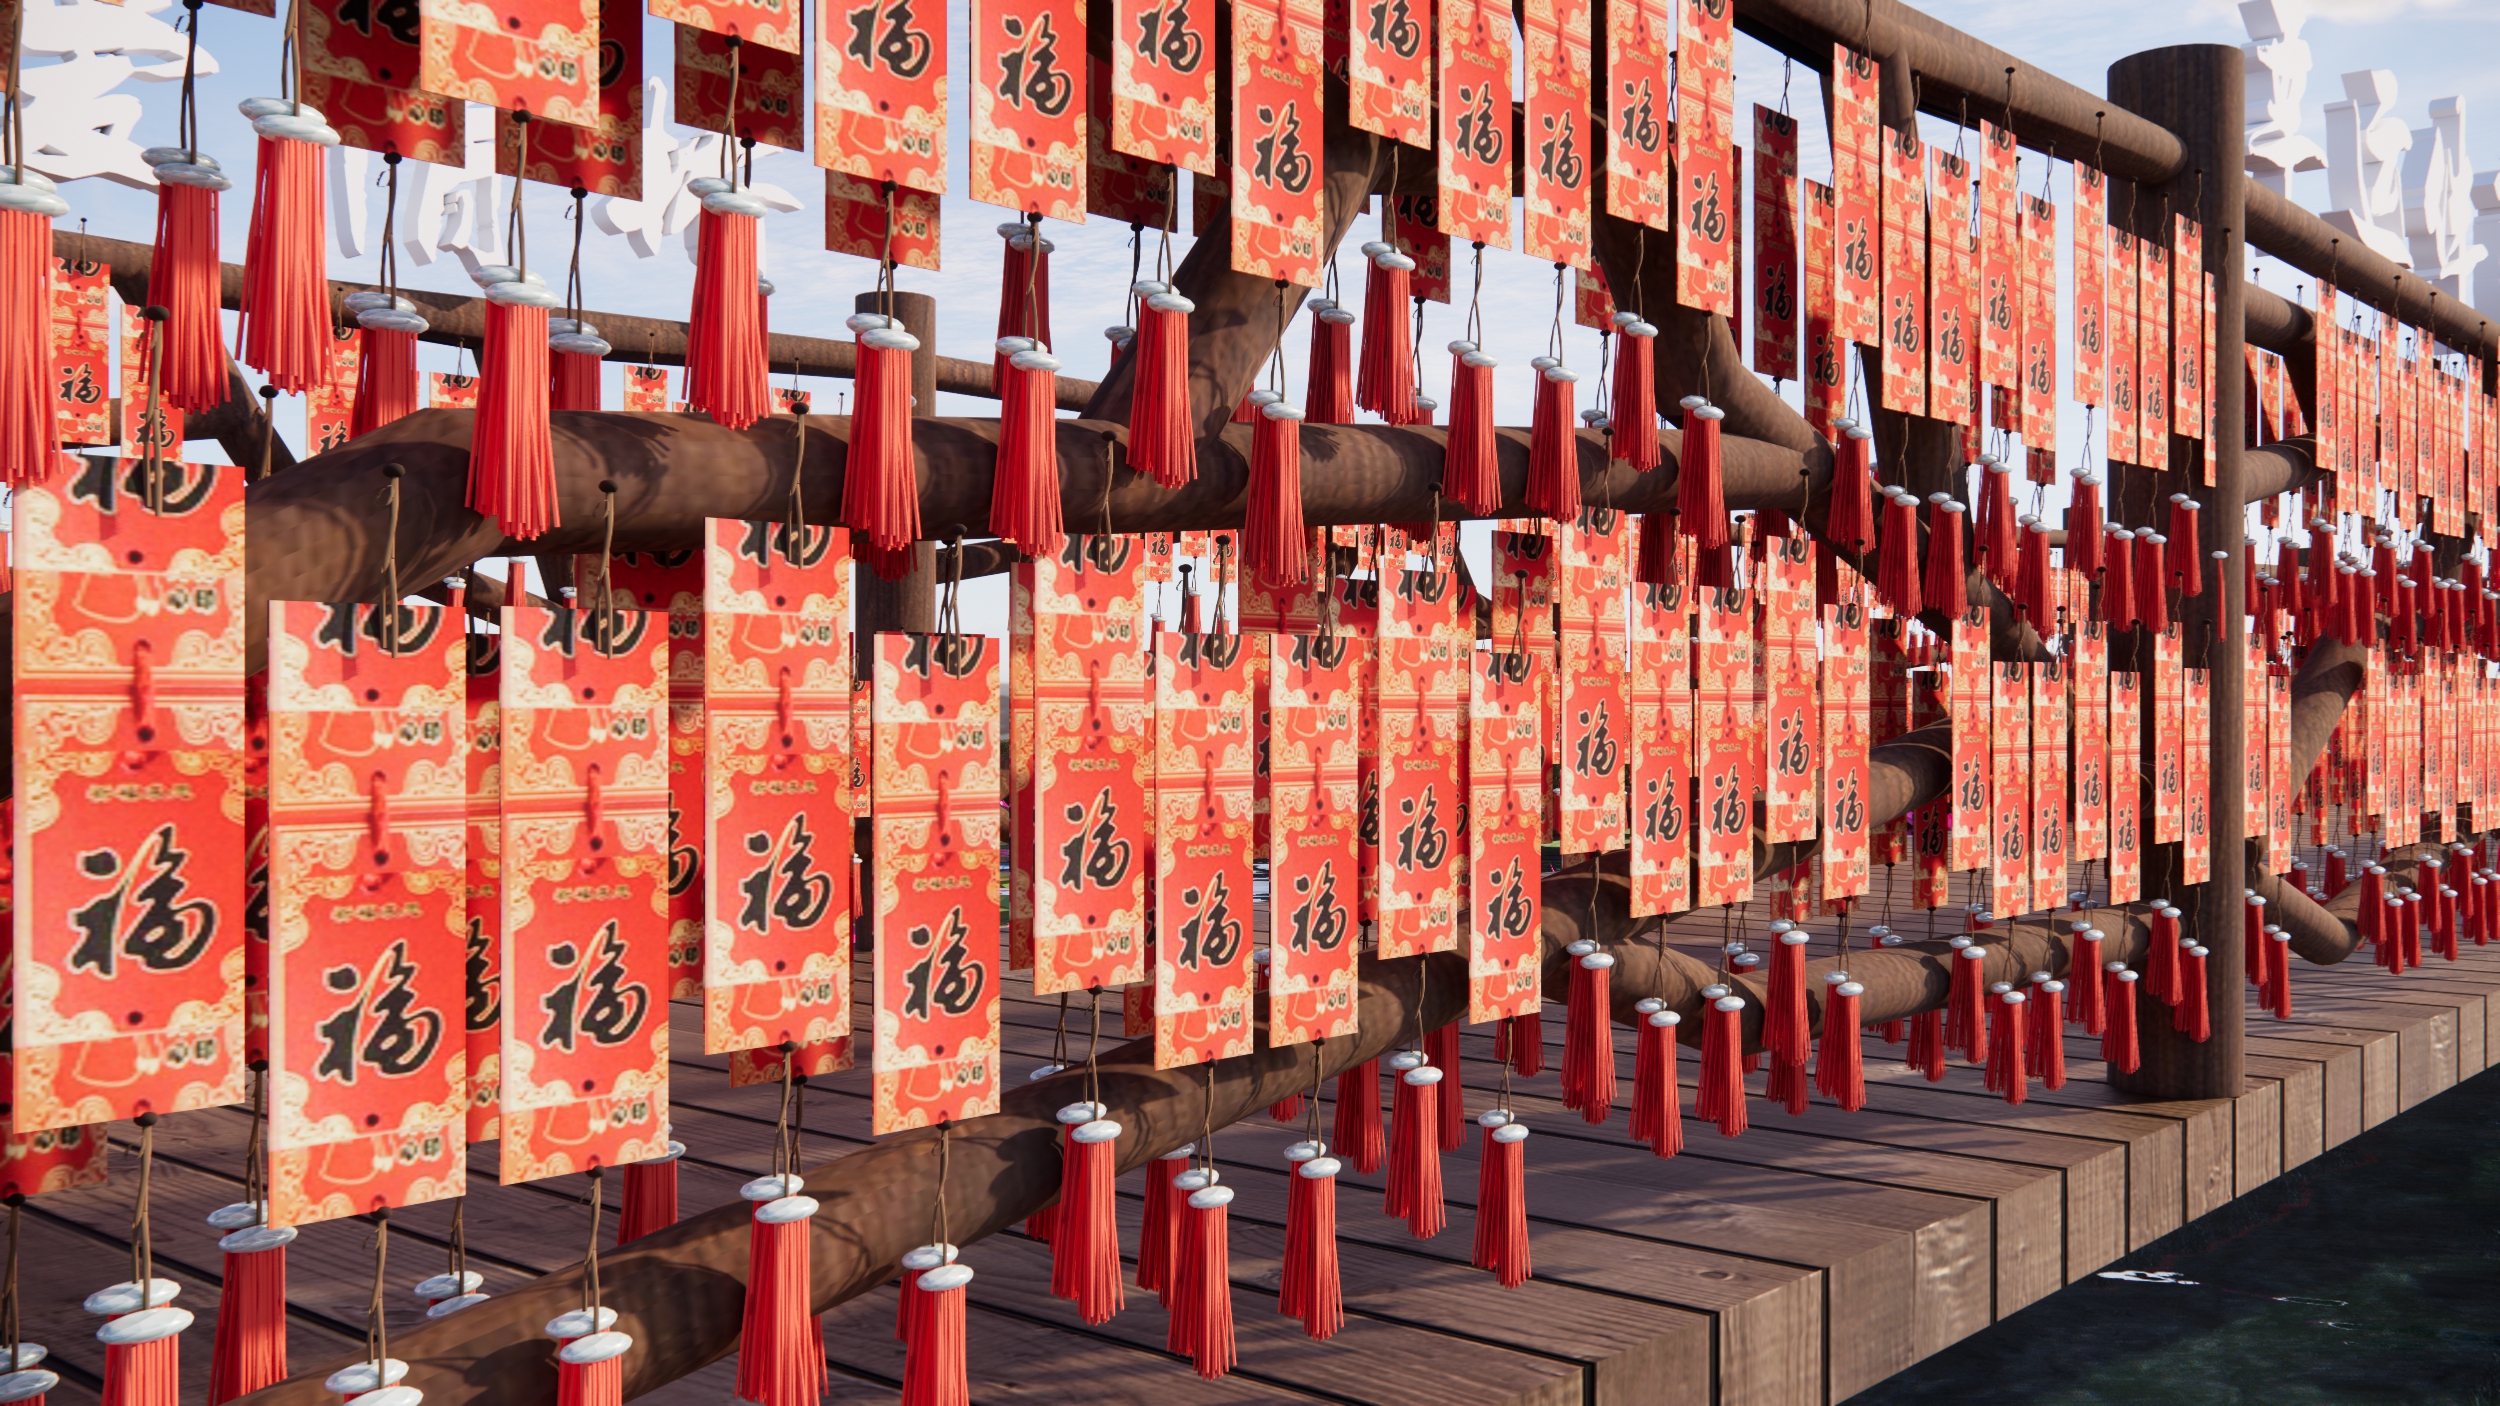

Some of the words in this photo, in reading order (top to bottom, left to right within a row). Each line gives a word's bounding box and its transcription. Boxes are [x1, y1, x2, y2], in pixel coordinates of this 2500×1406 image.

[847, 0, 932, 79] 福
[996, 10, 1073, 115] 福
[1137, 0, 1204, 74] 福
[1369, 0, 1421, 58] 福
[1252, 99, 1313, 193] 福
[1455, 80, 1503, 164] 福
[1539, 109, 1583, 188] 福
[1621, 76, 1661, 152] 福
[1690, 170, 1726, 242] 福
[1844, 215, 1873, 280] 福
[1763, 260, 1792, 320] 福
[1892, 290, 1919, 353] 福
[1988, 272, 2012, 330] 福
[1815, 331, 1840, 387] 福
[1940, 304, 1965, 365] 福
[2081, 301, 2100, 354] 福
[58, 362, 102, 403] 福
[2029, 338, 2051, 395] 福
[2114, 359, 2132, 412] 福
[2147, 369, 2164, 420] 福
[2181, 340, 2197, 390] 福
[1575, 697, 1617, 778] 福
[1777, 706, 1810, 777] 福
[2161, 743, 2178, 795] 福
[1644, 766, 1683, 844] 福
[1711, 762, 1746, 837] 福
[1834, 766, 1864, 835] 福
[1960, 751, 1985, 813] 福
[2082, 752, 2102, 809] 福
[2190, 787, 2206, 838] 福
[1059, 785, 1131, 893] 福
[1396, 782, 1448, 873] 福
[1921, 801, 1943, 857] 福
[2001, 802, 2024, 863] 福
[2041, 798, 2062, 856] 福
[2117, 799, 2136, 854] 福
[65, 821, 219, 979] 福
[737, 810, 833, 935] 福
[1289, 858, 1348, 955] 福
[1486, 854, 1533, 941] 福
[1177, 869, 1242, 972] 福
[538, 917, 650, 1053] 福
[901, 904, 985, 1022] 福
[313, 937, 444, 1085] 福
